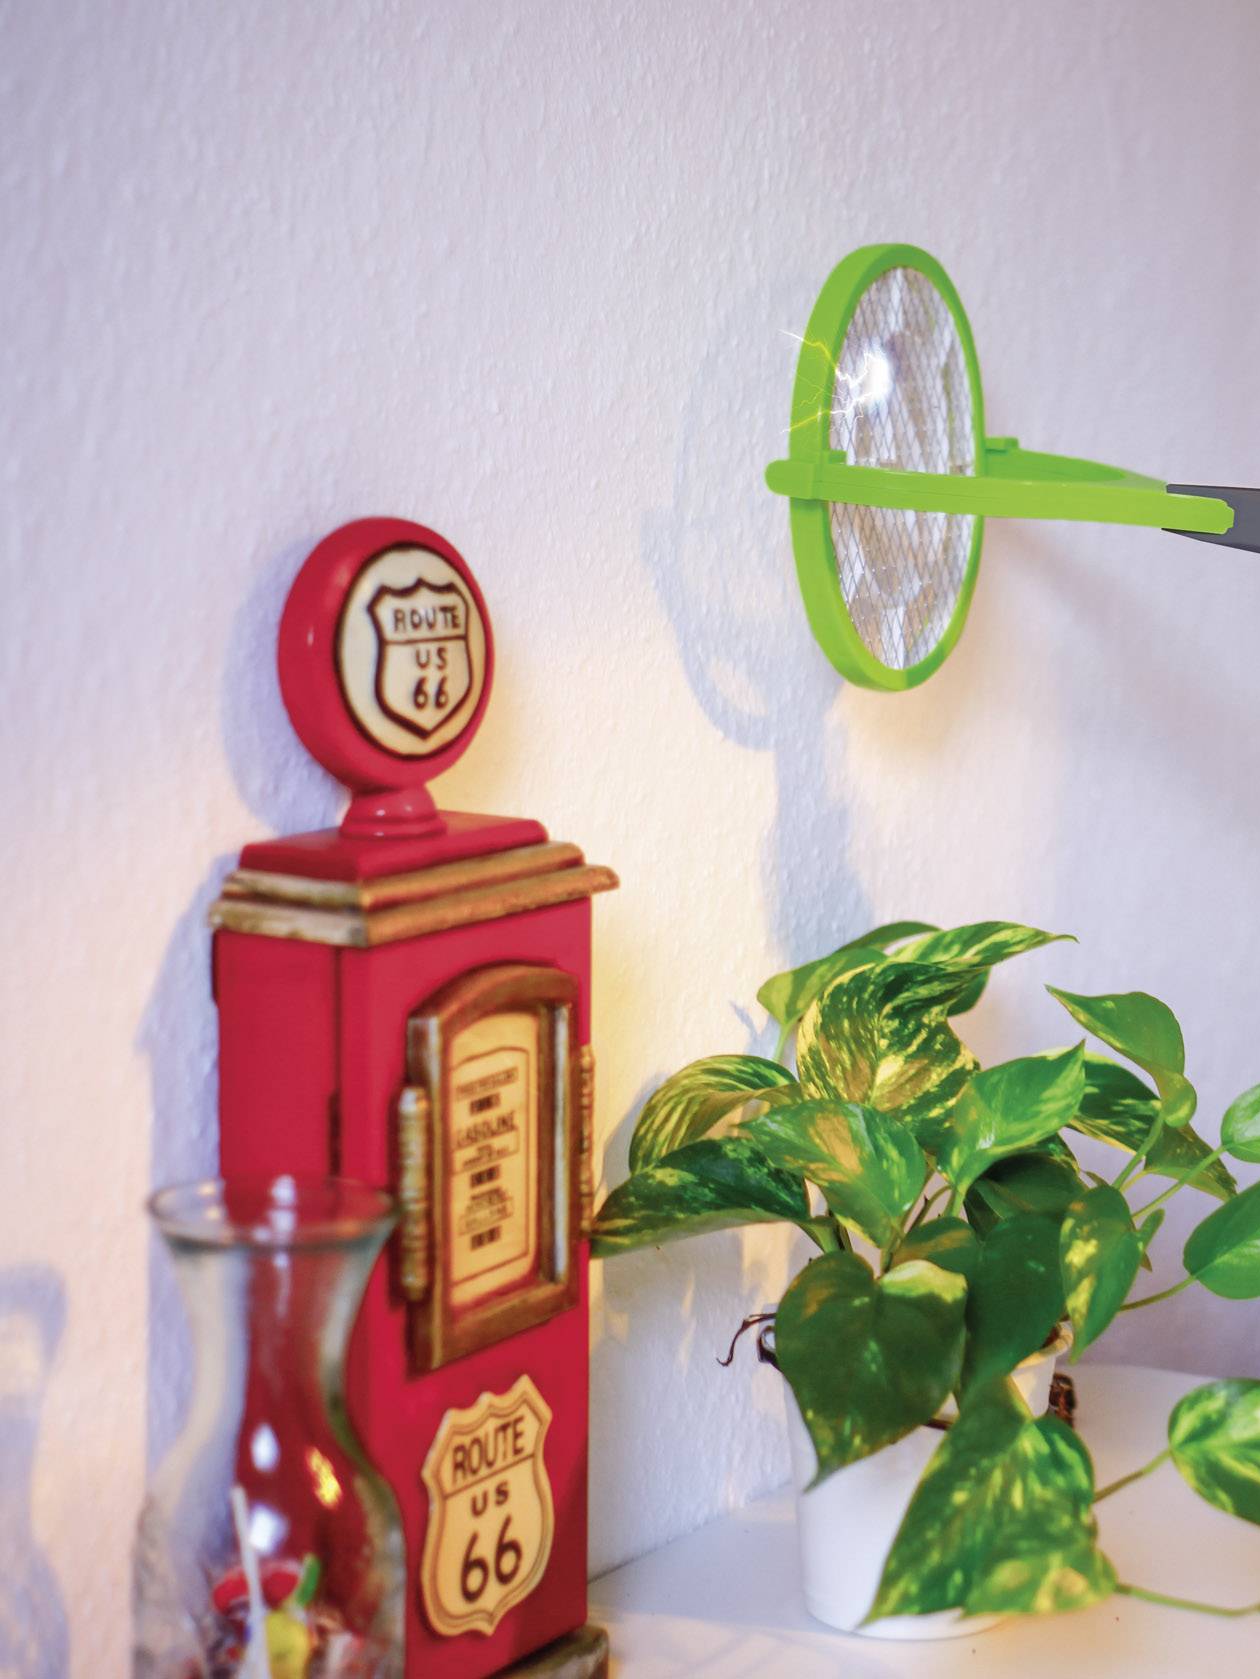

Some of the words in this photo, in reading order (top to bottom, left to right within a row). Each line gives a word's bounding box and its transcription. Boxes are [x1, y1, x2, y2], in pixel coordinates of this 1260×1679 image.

[393, 605, 460, 633] ROUTE
[416, 646, 447, 671] US
[414, 676, 448, 710] 66
[452, 1416, 525, 1486] ROUTE
[471, 1480, 510, 1518] US
[460, 1513, 524, 1604] 66
